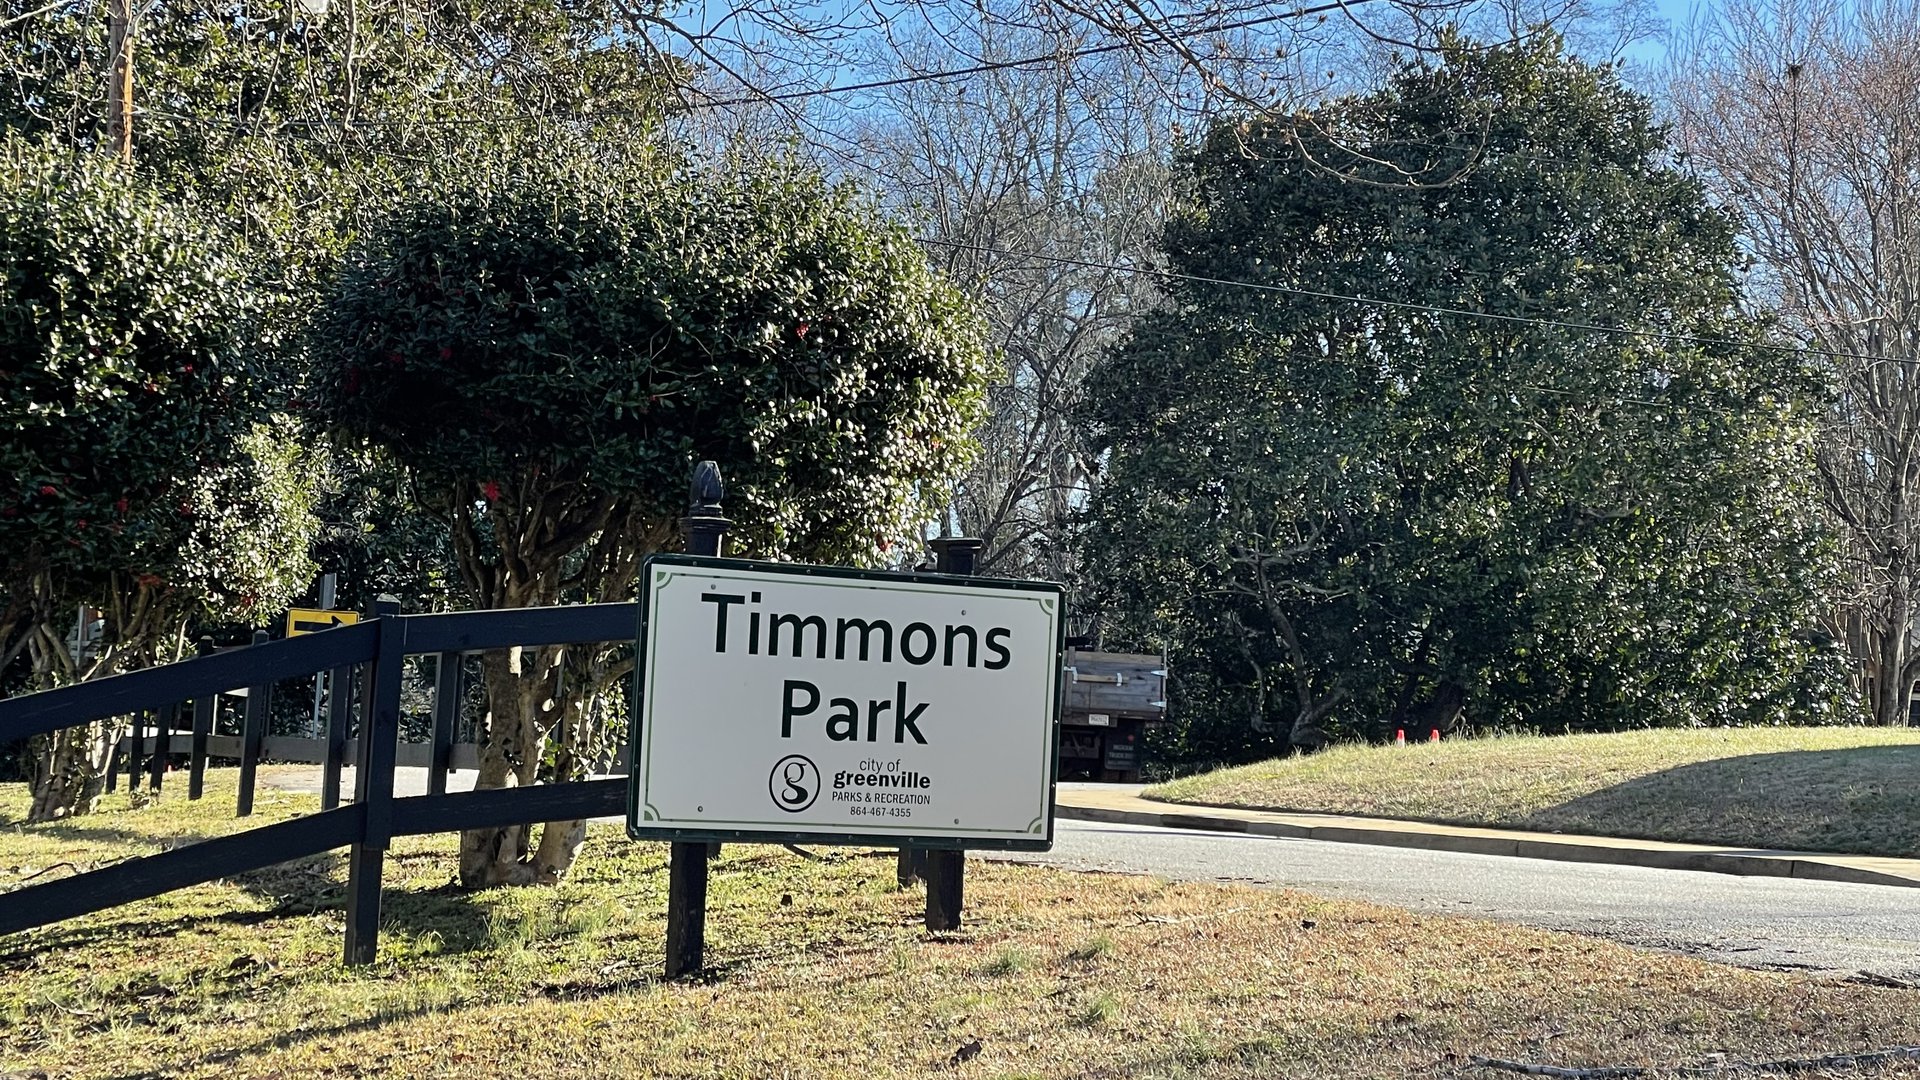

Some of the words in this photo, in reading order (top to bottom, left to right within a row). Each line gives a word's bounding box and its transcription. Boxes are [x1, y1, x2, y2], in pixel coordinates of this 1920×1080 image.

[700, 591, 1011, 671] Timmons
[780, 680, 931, 745] Park
[859, 759, 884, 774] city
[887, 758, 901, 773] of
[833, 770, 931, 789] greenville
[831, 791, 862, 802] PARKS
[865, 792, 872, 803] &
[874, 793, 931, 805] RECREATION
[850, 806, 911, 818] 864-467-4355
